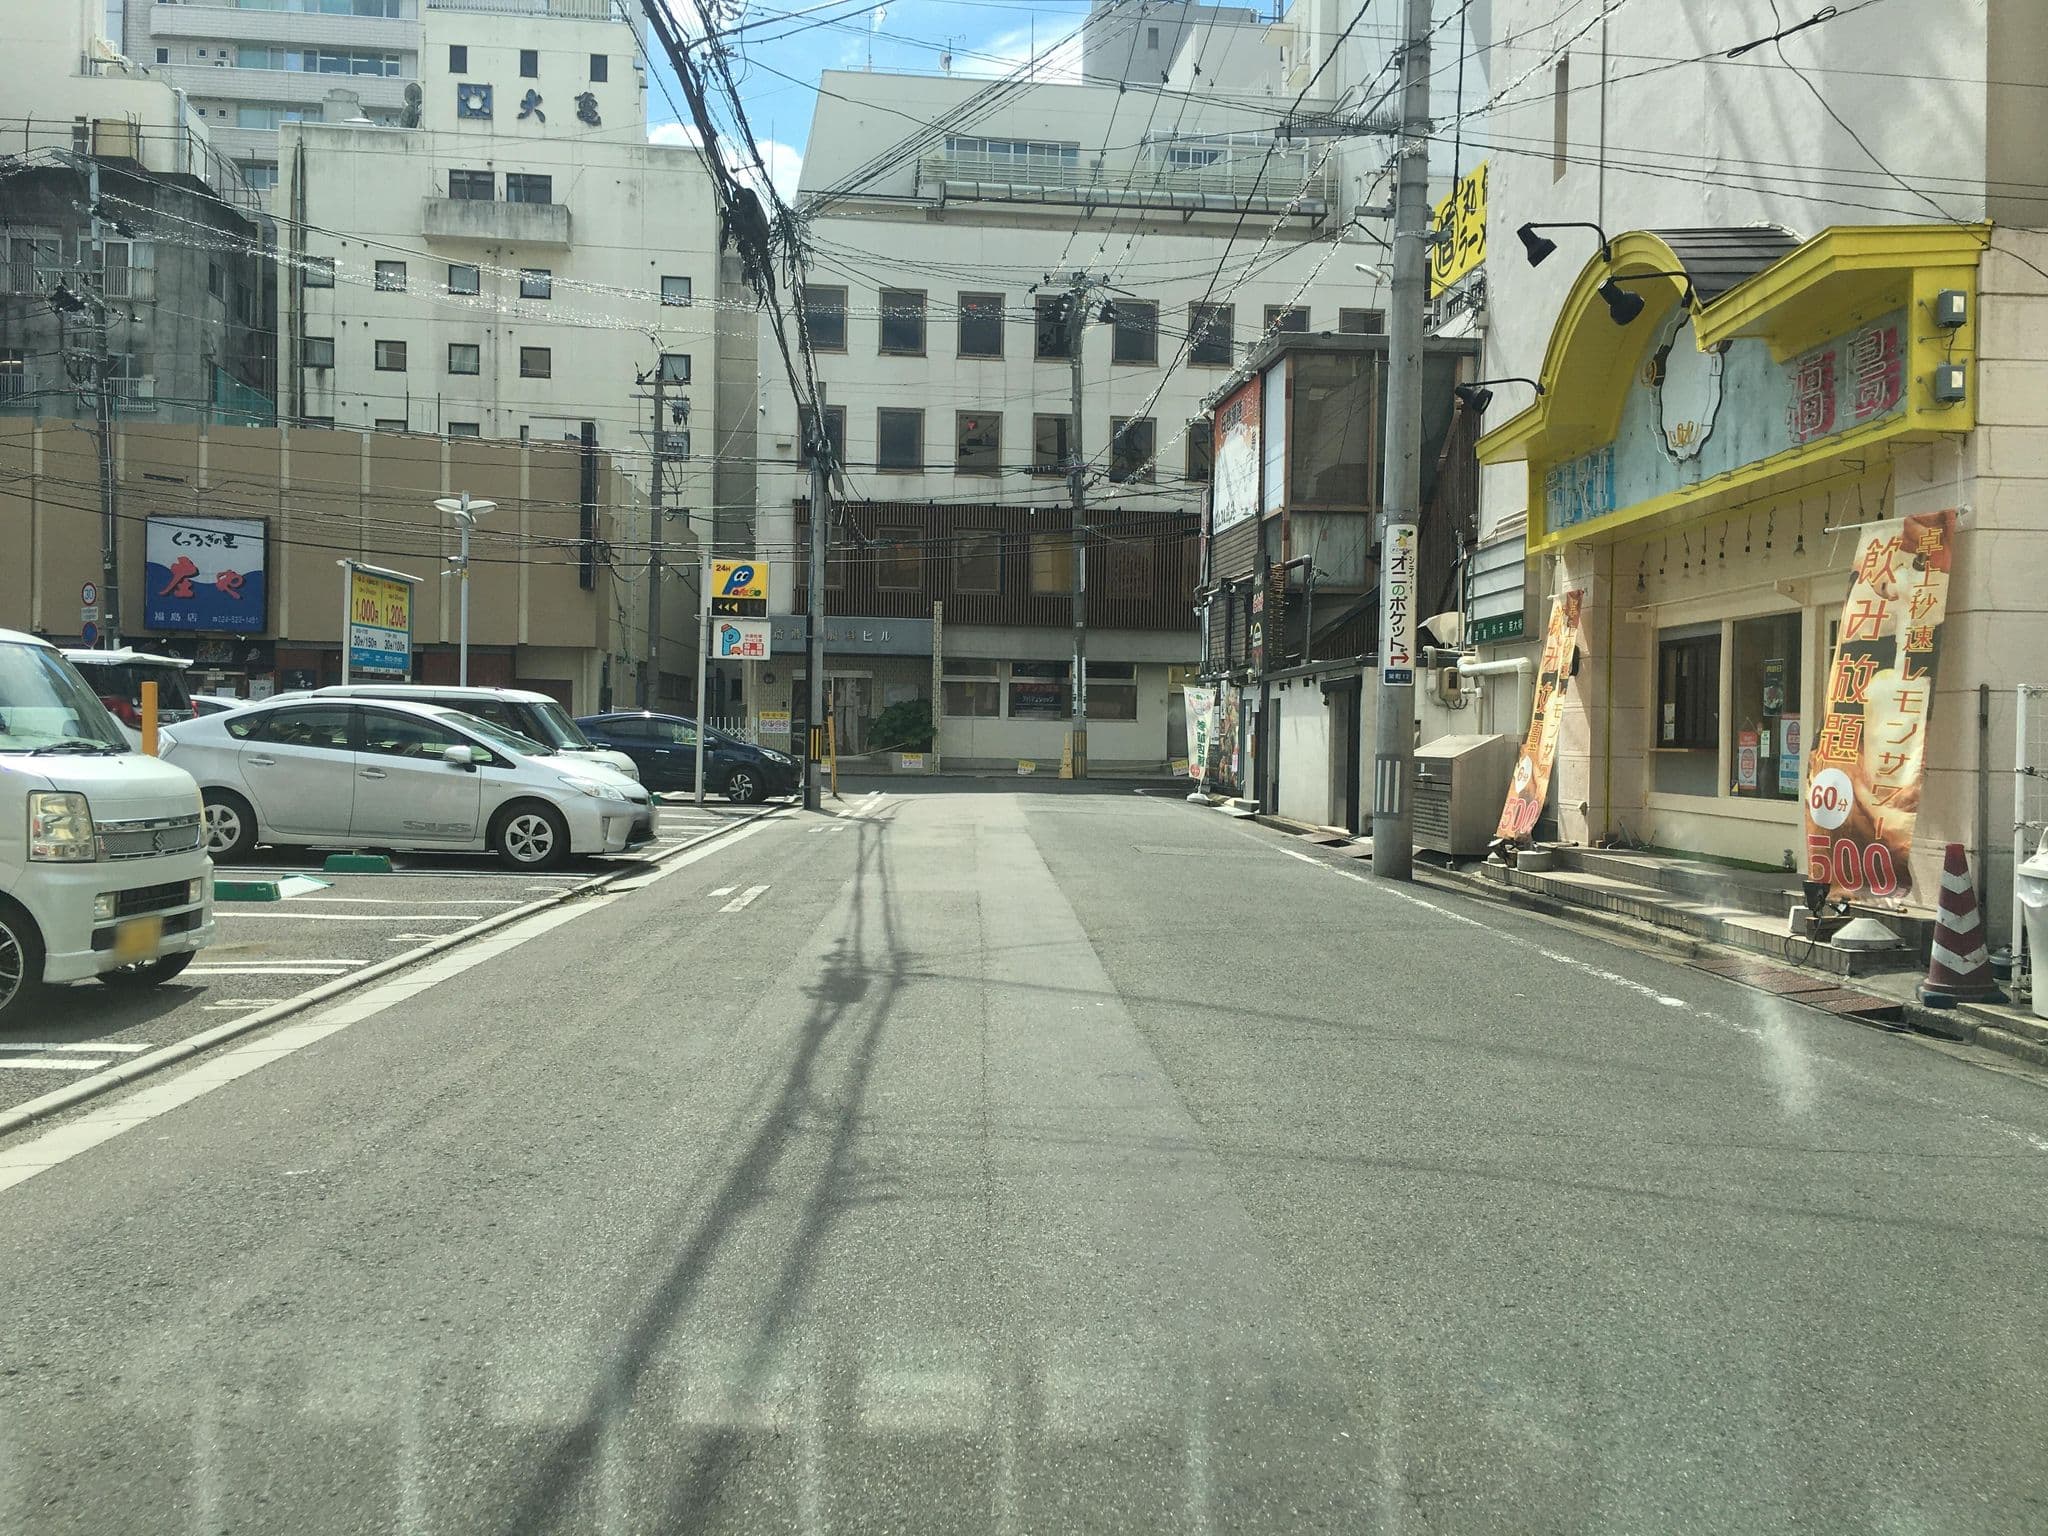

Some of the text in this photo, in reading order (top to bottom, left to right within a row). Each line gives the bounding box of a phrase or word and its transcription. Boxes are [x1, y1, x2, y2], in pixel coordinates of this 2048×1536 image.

[159, 556, 244, 600] 庄や
[1389, 556, 1409, 652] オニのポケット
[1815, 537, 1903, 765] 飲み放題
[1871, 527, 1944, 840] 卓上秒速レモンサワー
[1811, 784, 1849, 812] 60分
[1808, 833, 1898, 896] 500
